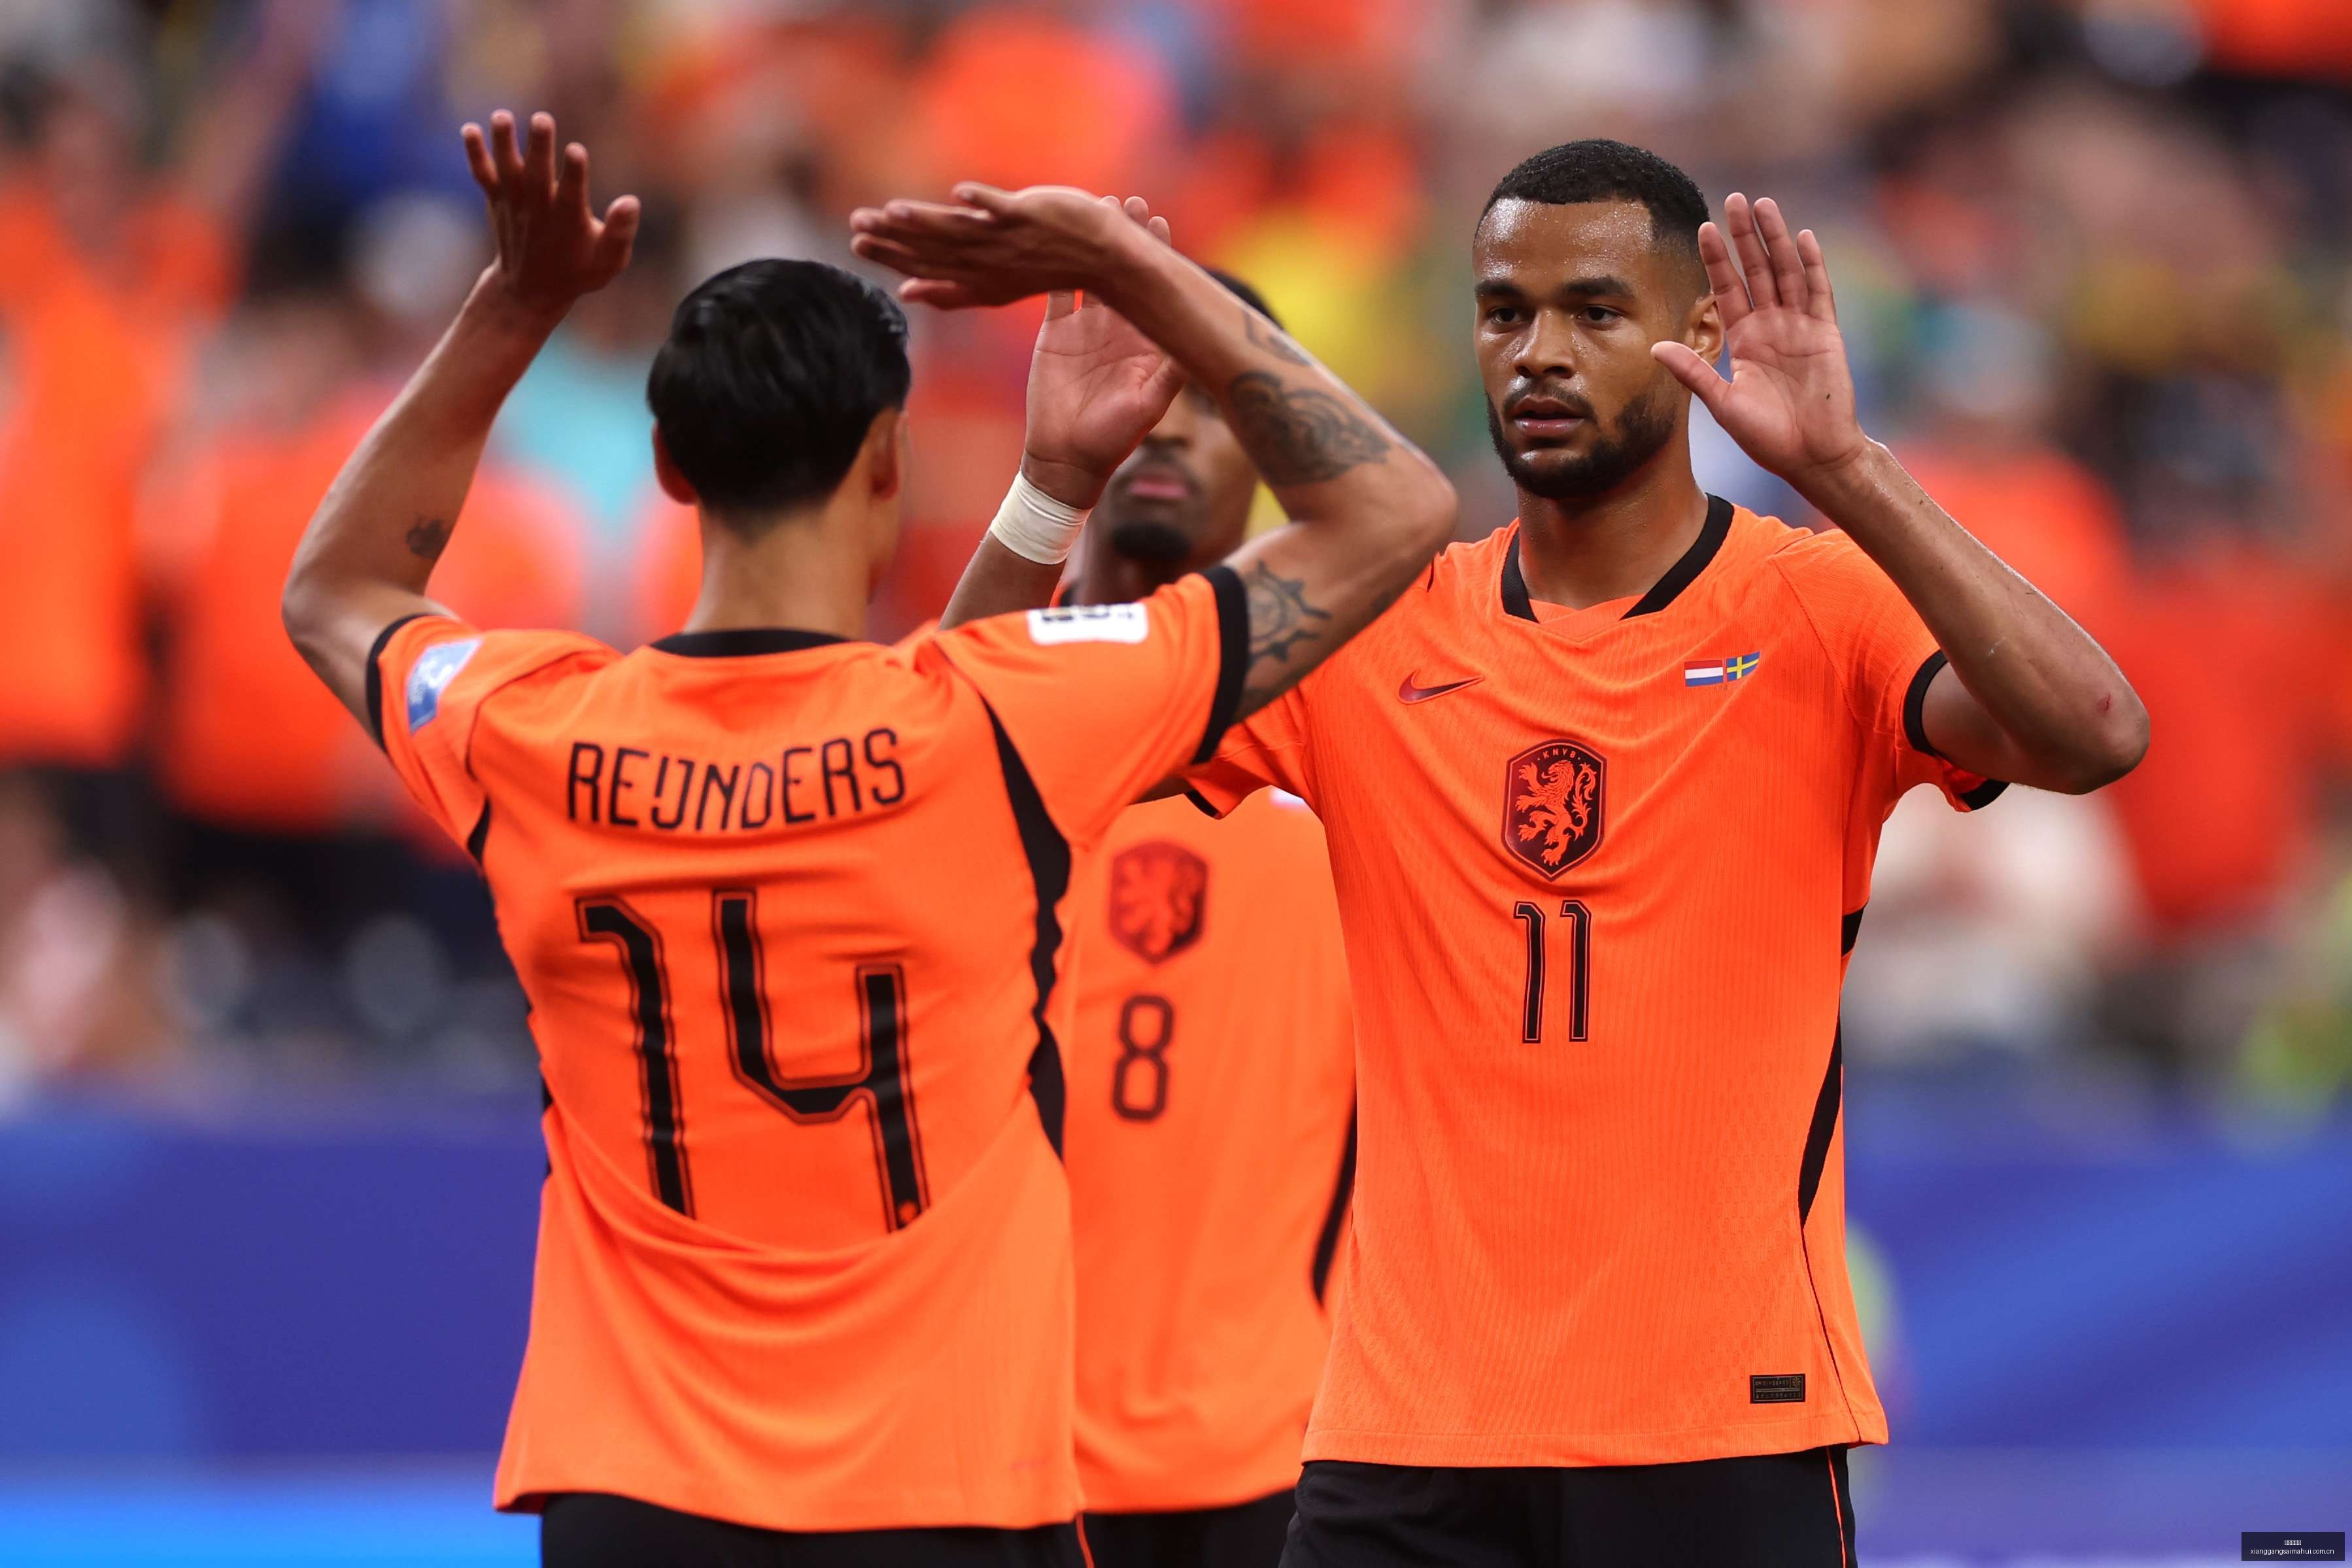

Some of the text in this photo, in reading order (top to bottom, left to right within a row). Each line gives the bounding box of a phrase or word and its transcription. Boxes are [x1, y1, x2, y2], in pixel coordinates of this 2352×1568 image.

[568, 726, 907, 833] REIJNDERS
[1543, 748, 1576, 758] KNVB
[1514, 900, 1592, 1043] 11
[574, 887, 931, 1235] 14
[1113, 994, 1174, 1121] 8
